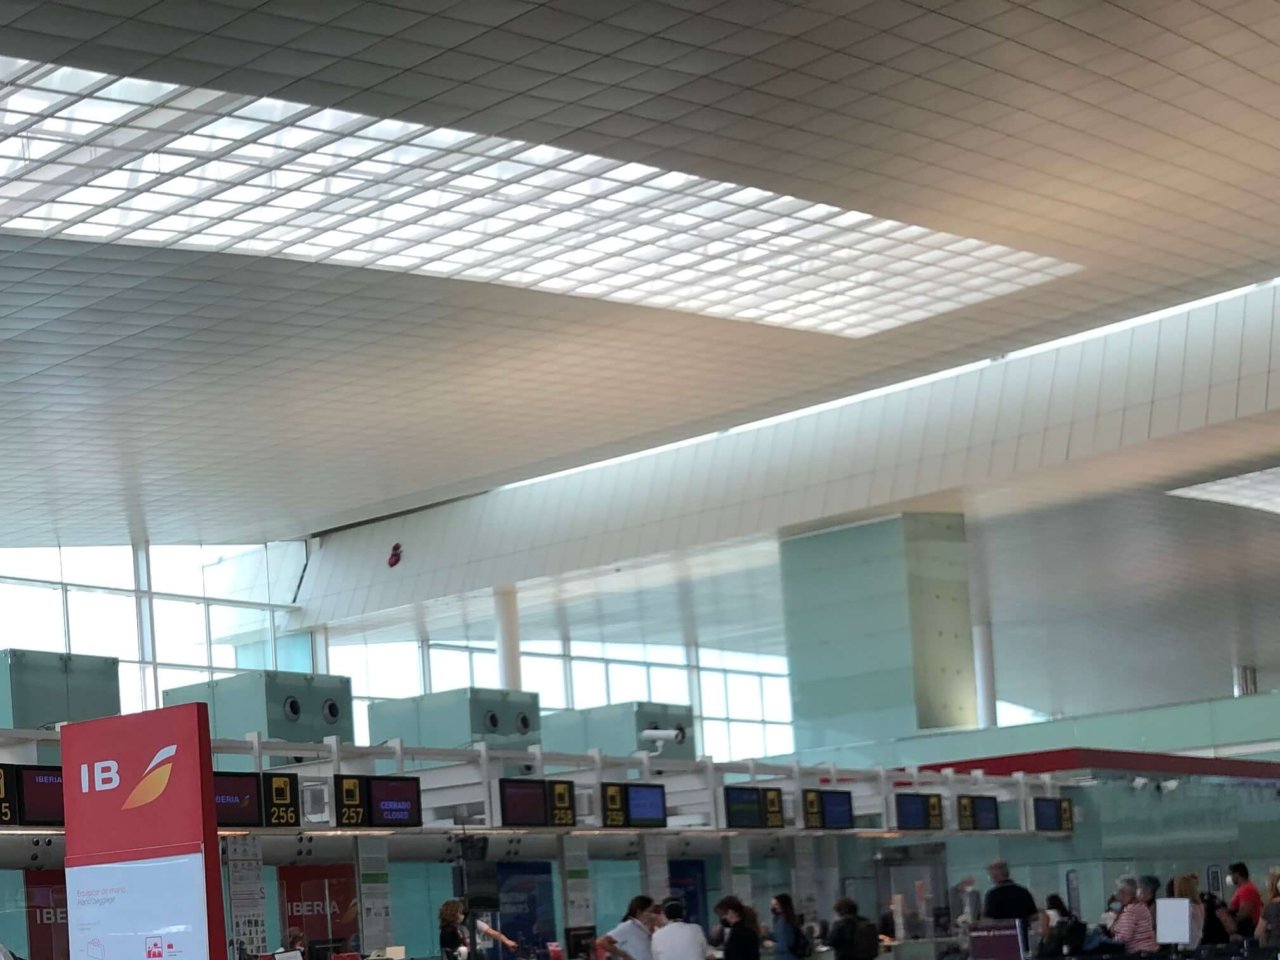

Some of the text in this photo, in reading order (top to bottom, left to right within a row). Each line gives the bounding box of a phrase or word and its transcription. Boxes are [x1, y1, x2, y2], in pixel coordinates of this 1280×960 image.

[35, 775, 62, 784] IBERIA
[81, 760, 120, 793] IB
[214, 795, 240, 804] BERIA
[271, 806, 296, 824] 256
[342, 807, 364, 824] 257
[35, 908, 68, 924] IBE
[287, 900, 340, 916] IBERIA
